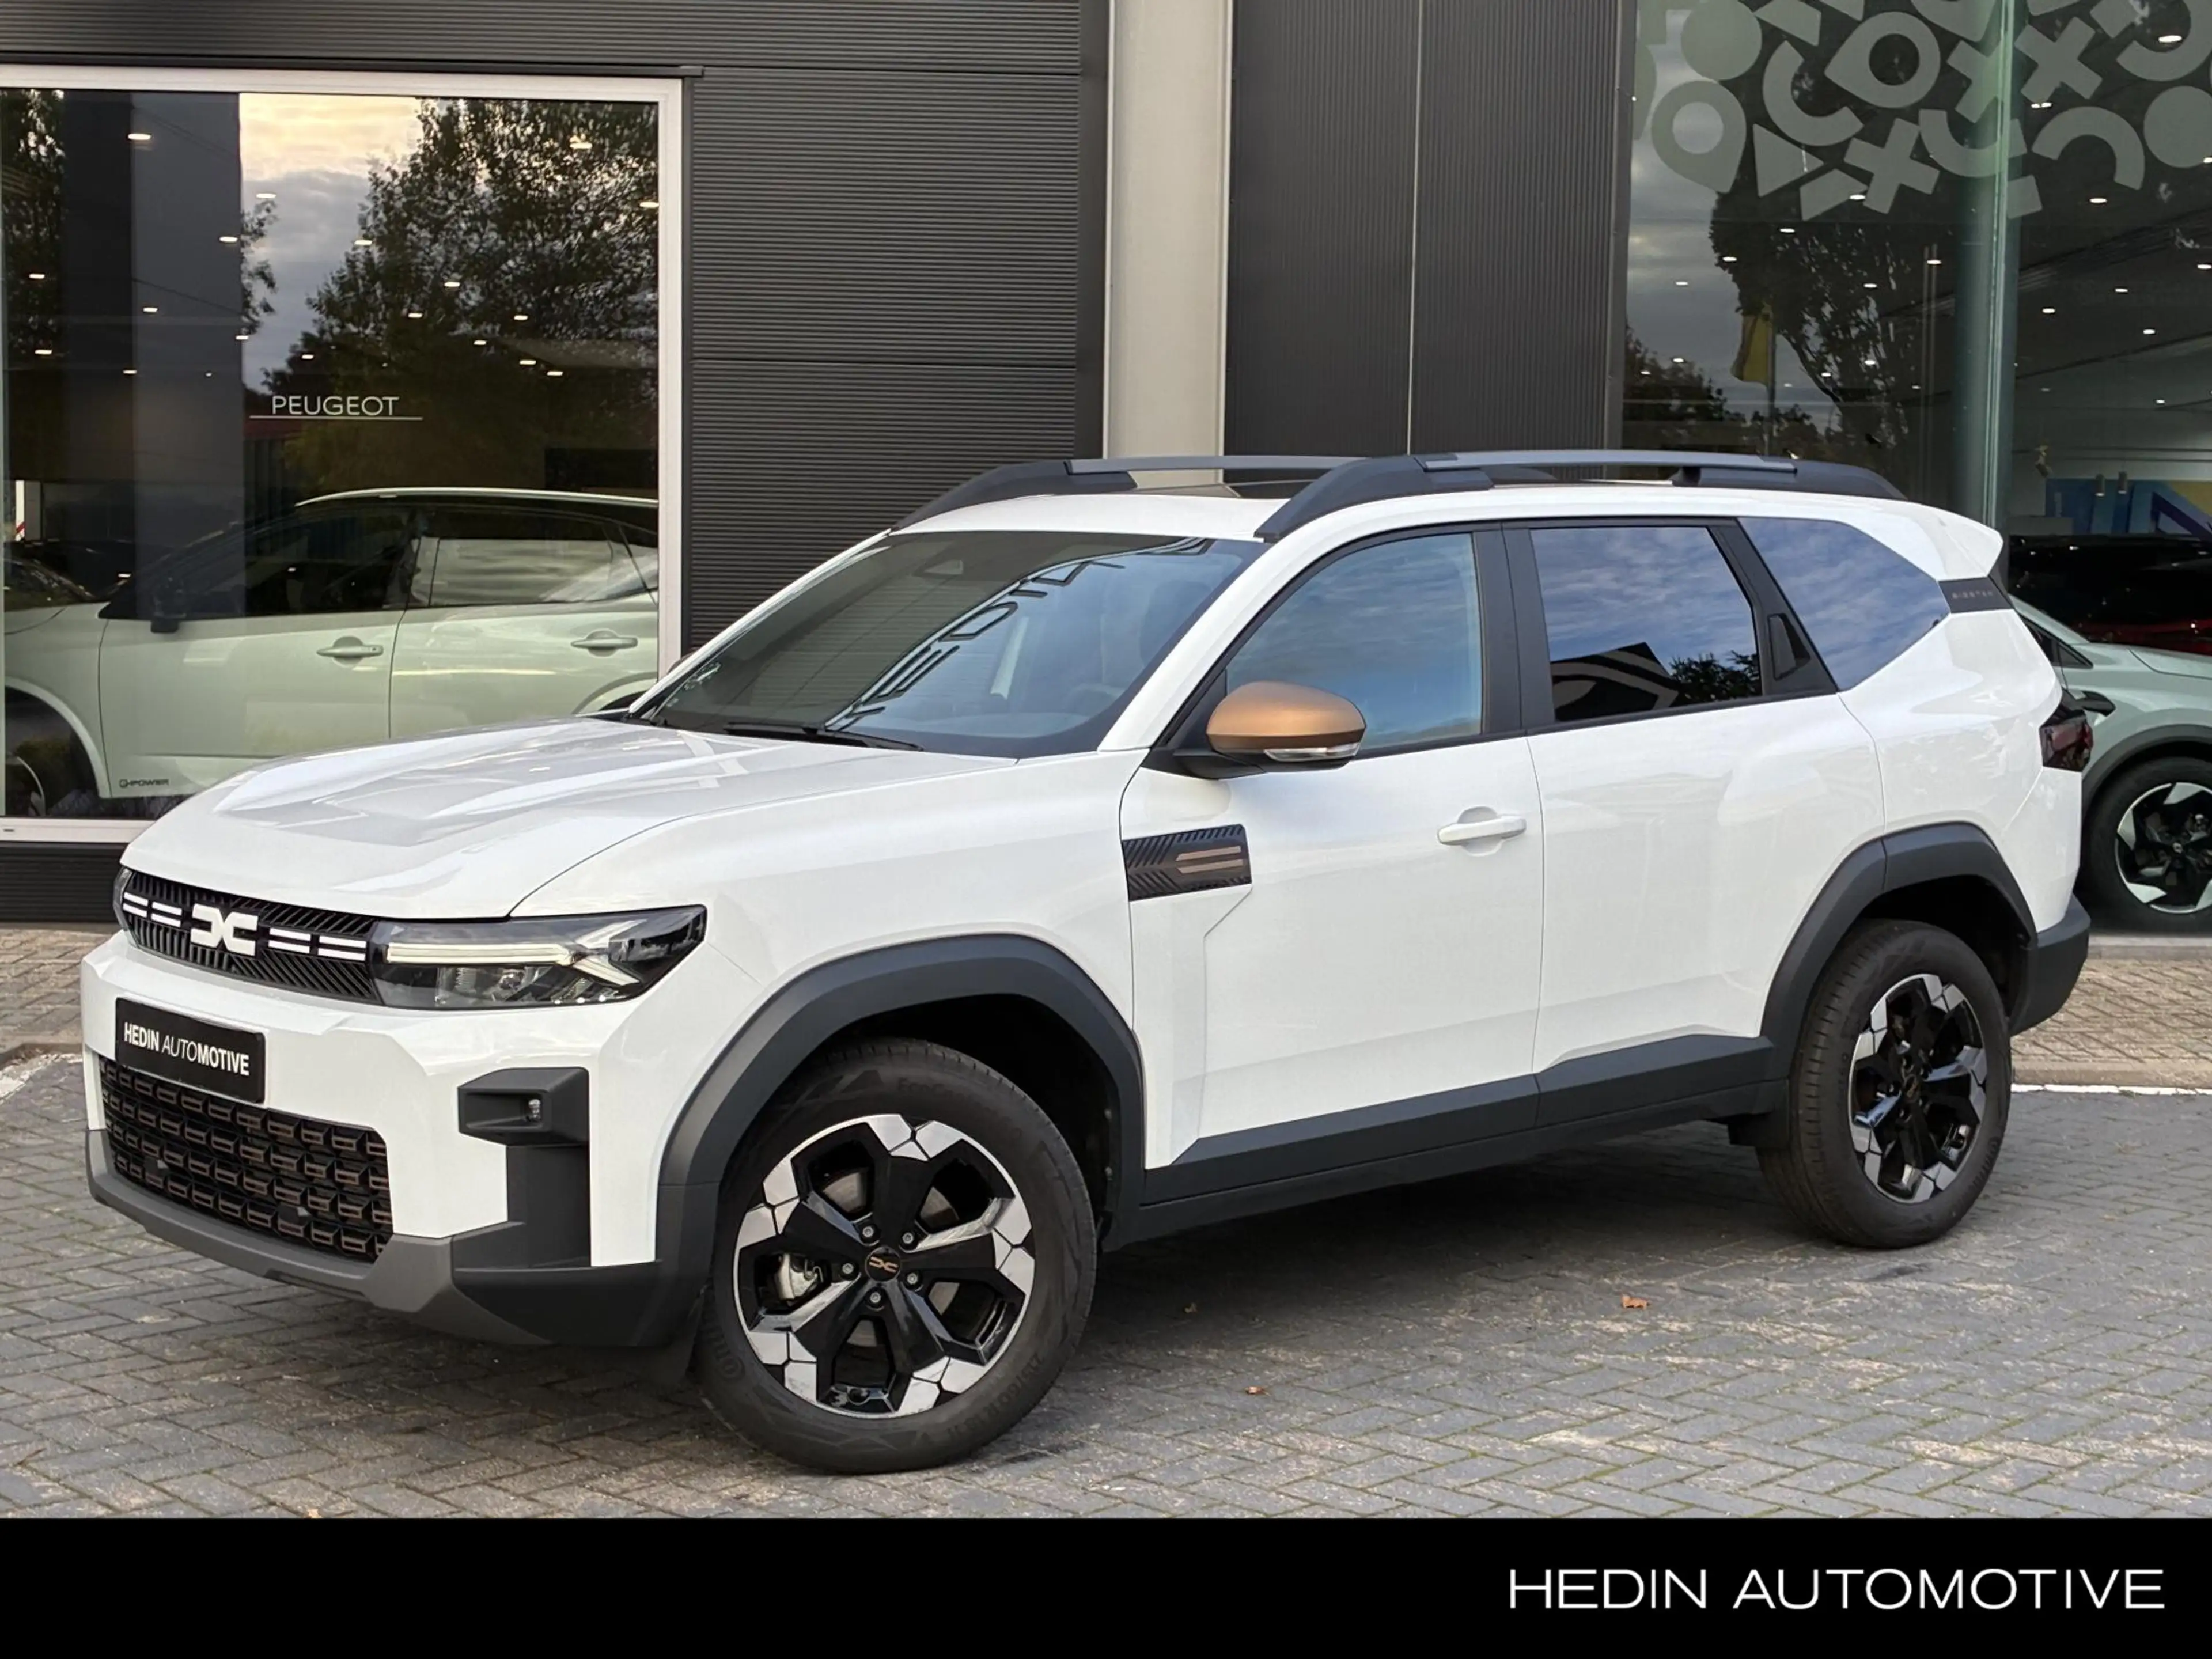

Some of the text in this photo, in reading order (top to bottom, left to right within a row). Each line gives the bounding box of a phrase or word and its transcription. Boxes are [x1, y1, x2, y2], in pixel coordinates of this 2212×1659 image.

[271, 396, 400, 416] PEUGEOT
[124, 1022, 249, 1075] HEDIN AUTOMOTIVE
